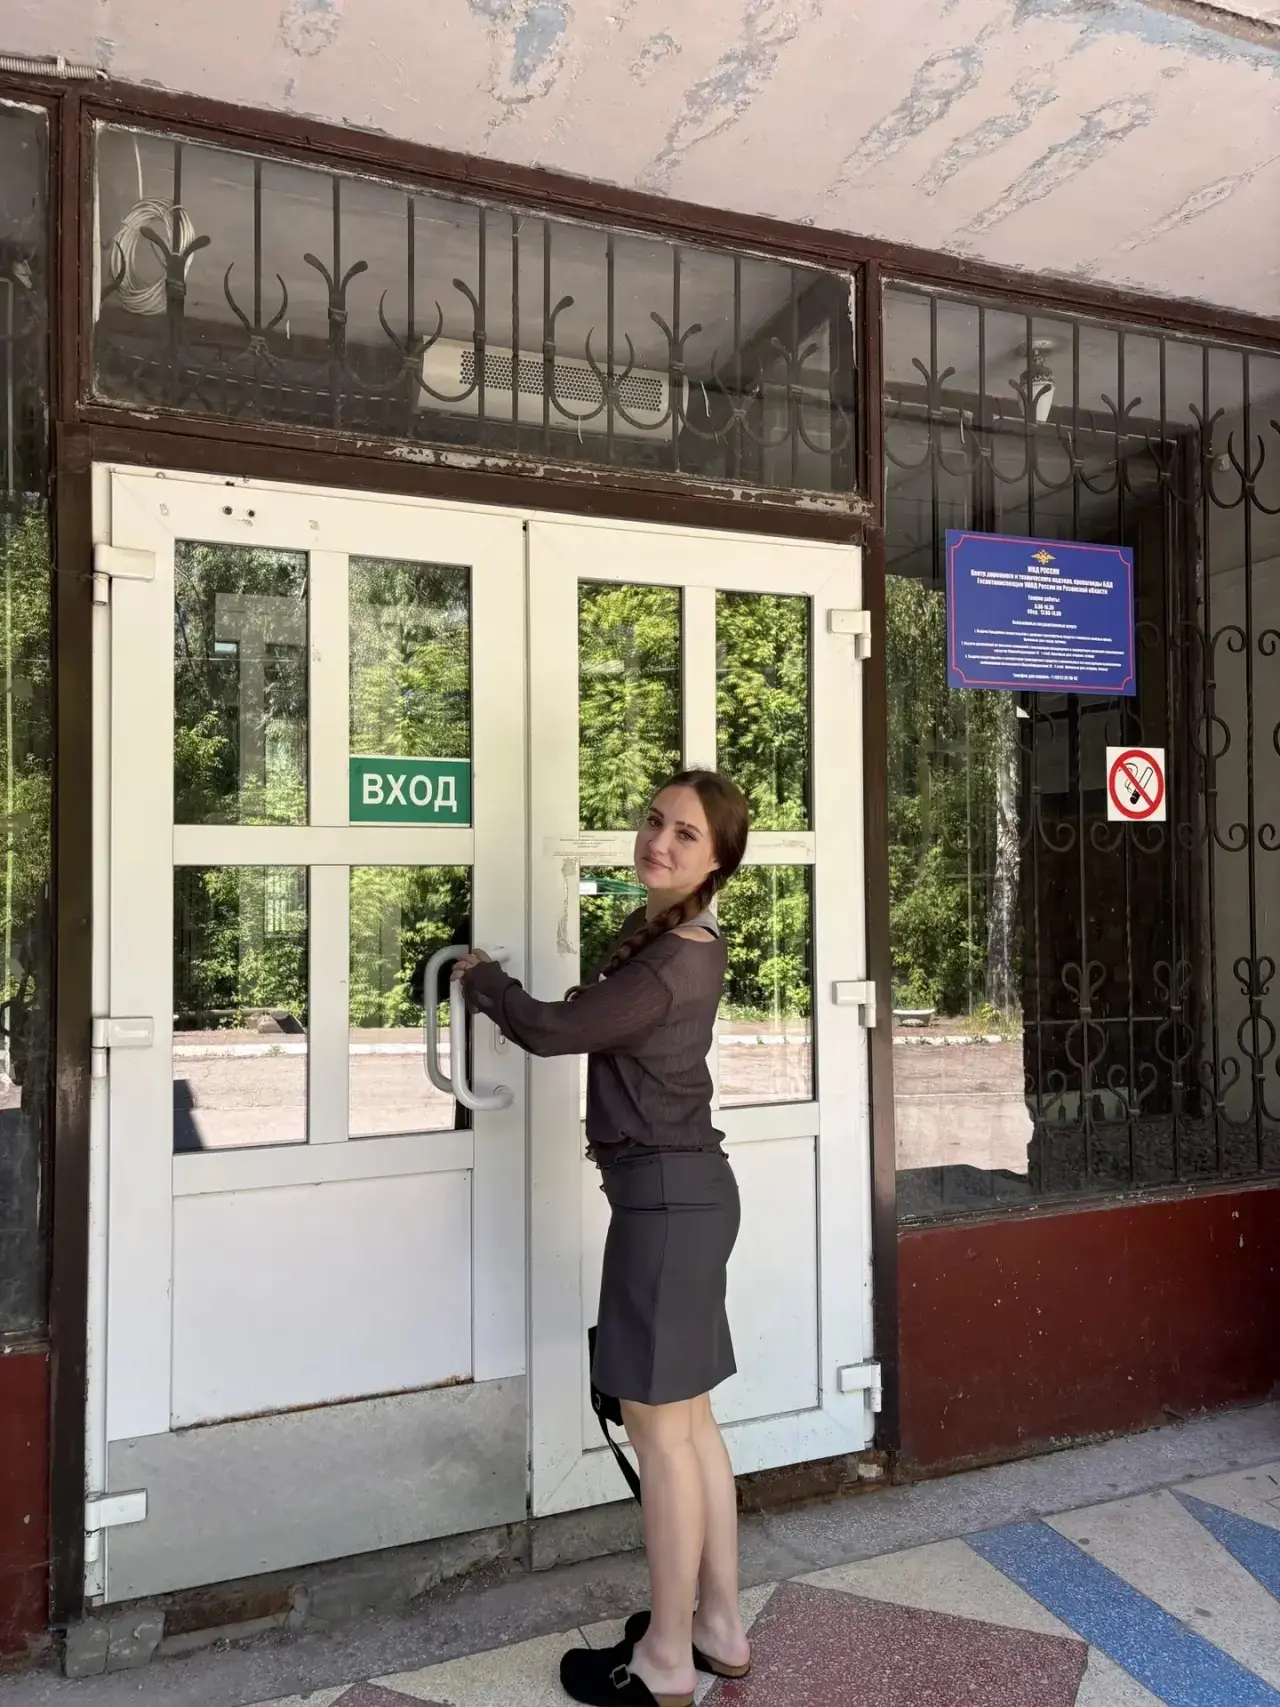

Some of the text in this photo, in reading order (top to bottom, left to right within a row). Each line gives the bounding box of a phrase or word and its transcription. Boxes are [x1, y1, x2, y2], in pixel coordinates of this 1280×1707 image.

[971, 569, 986, 578] Центр
[1019, 574, 1051, 582] технического
[1073, 579, 1102, 588] пропаганды
[1103, 580, 1113, 588] БДД
[1027, 566, 1060, 575] МВД РОССИИ
[1024, 581, 1038, 590] УМВД
[1038, 582, 1056, 590] России
[1063, 584, 1088, 593] Рязанской
[1088, 587, 1108, 595] области
[362, 773, 458, 813] ВХОД
